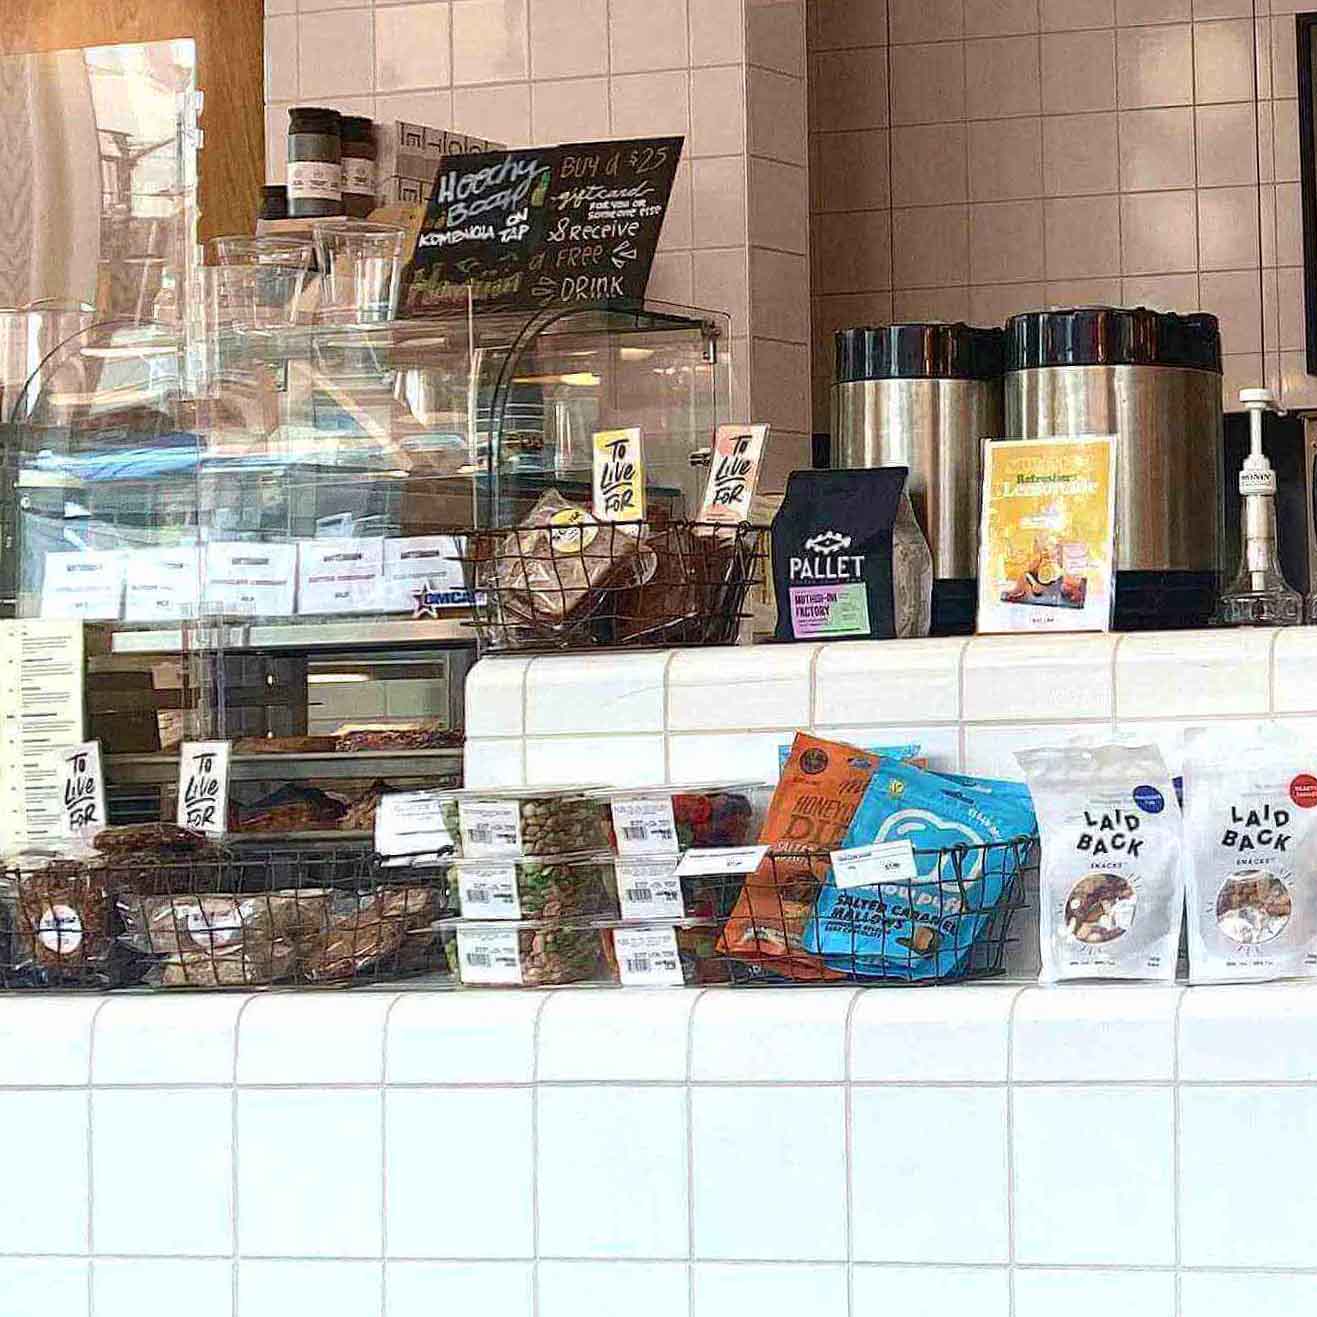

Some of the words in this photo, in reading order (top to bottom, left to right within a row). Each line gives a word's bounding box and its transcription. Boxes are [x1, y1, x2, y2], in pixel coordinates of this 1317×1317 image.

[560, 155, 600, 178] BUY
[628, 147, 669, 174] $25
[505, 208, 528, 226] ON
[498, 225, 529, 242] TAP
[790, 555, 865, 580] PALLET
[1084, 810, 1140, 831] LAID
[1231, 804, 1289, 827] LAID
[1077, 833, 1144, 856] BACK
[1222, 829, 1291, 851] BACK
